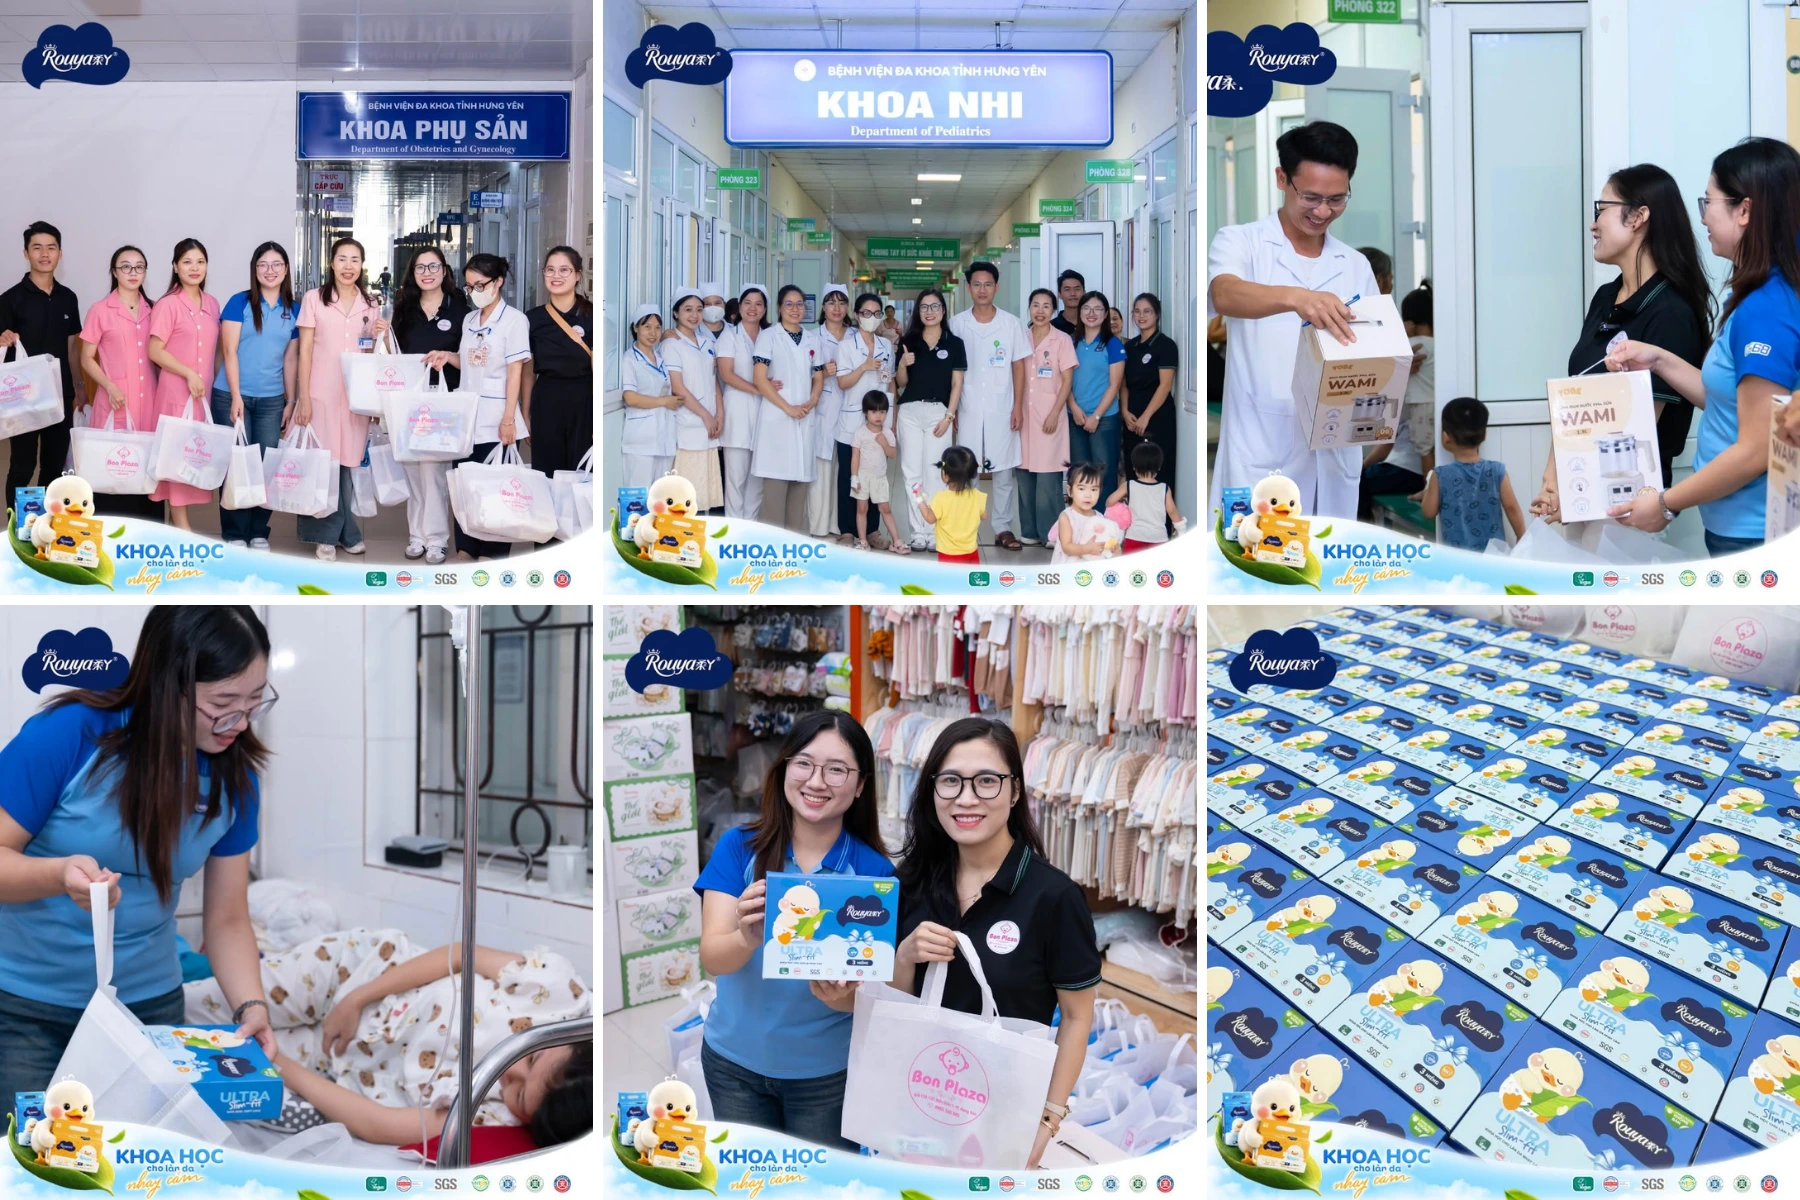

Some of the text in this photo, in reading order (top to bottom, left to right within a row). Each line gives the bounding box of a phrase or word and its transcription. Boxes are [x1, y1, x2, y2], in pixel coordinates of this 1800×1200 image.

[1376, 1, 1396, 14] 322
[828, 60, 1047, 79] BỆNH VIỆN ĐA KHOA TỈNH HƯNG YÊN
[368, 101, 392, 112] BỆNH
[393, 101, 414, 112] VIỆN
[455, 99, 478, 110] TỈNH
[478, 102, 505, 110] HƯNG
[506, 100, 524, 110] YÊN
[817, 90, 1023, 119] KHOA NHI
[339, 114, 528, 144] KHOA PHỤ SẢN
[850, 124, 991, 138] Department of Pediatrics
[351, 144, 516, 155] Department of Obstetrics and Gynecology
[1089, 165, 1131, 177] PHÒNG 328
[720, 173, 758, 184] PHÒNG 323
[1328, 377, 1377, 390] WAMI
[1559, 407, 1616, 427] WAMI
[1592, 621, 1636, 632] Bon Plaza
[1713, 636, 1763, 660] Bon Plaza
[1450, 924, 1488, 951] ULTRA
[1634, 919, 1680, 945] ULTRA
[1256, 929, 1292, 957] ULTRA
[780, 946, 822, 956] ULTRA
[1360, 1005, 1401, 1040] ULTRA
[1577, 1000, 1626, 1036] ULTRA
[1366, 1046, 1380, 1058] SGS
[1598, 1041, 1614, 1053] SGS
[1419, 1067, 1425, 1075] 3
[1658, 1062, 1666, 1070] 3
[911, 1069, 941, 1088] Bon
[944, 1078, 987, 1104] Plaza
[220, 1091, 270, 1103] ULTRA
[1495, 1108, 1550, 1157] ULTRA
